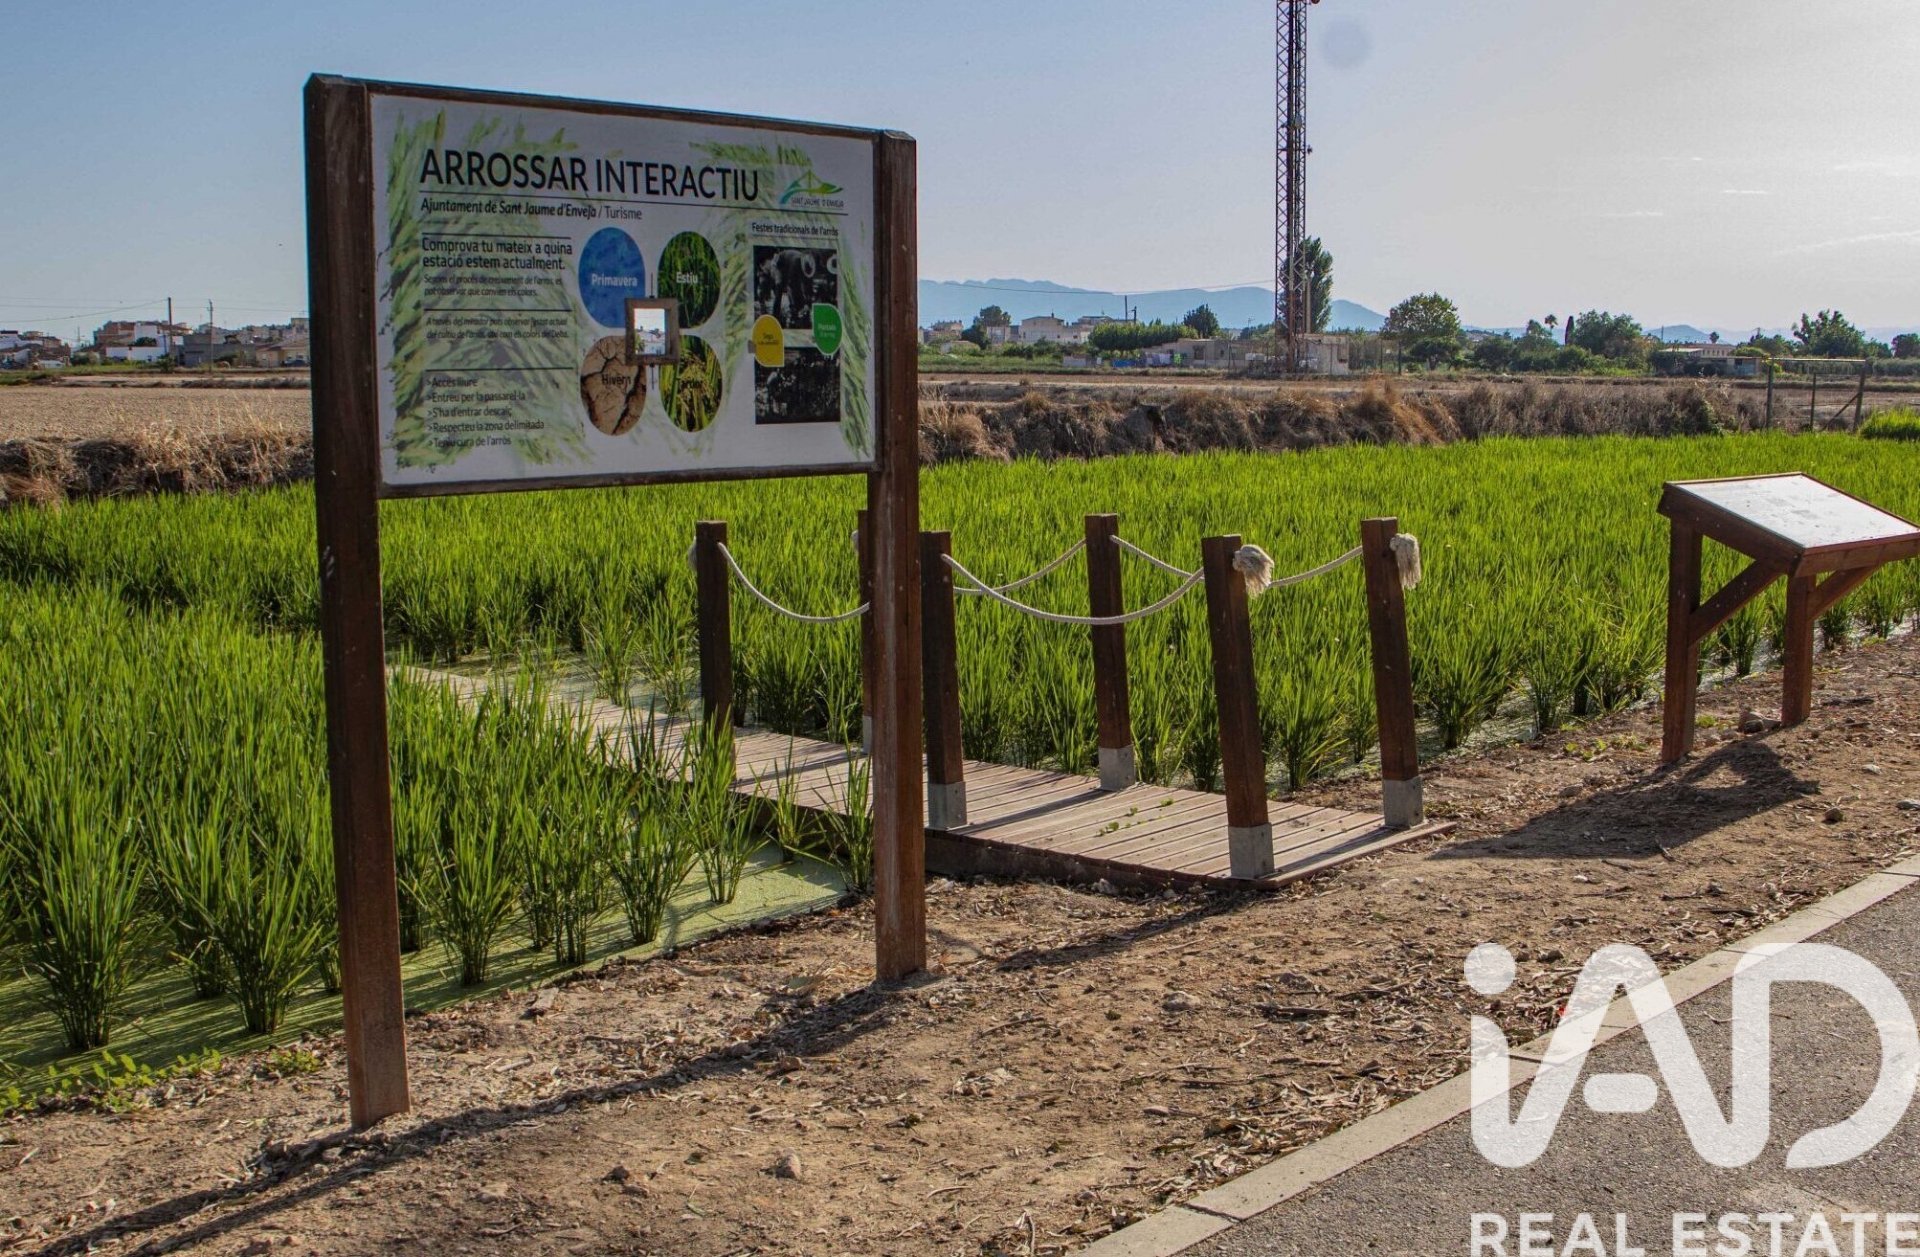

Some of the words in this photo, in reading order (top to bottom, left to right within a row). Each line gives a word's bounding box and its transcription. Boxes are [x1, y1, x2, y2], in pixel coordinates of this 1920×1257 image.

[419, 149, 589, 191] ARROSSAR
[596, 159, 758, 201] INTERACTIU
[420, 197, 483, 216] Ajuntament
[485, 198, 497, 213] de
[499, 200, 521, 214] Sant
[523, 202, 556, 216] Jaume
[604, 206, 642, 219] Turisme
[752, 222, 773, 233] Festes
[774, 223, 810, 234] tradicionals
[811, 225, 819, 233] de
[422, 237, 479, 254] Comprova
[481, 239, 493, 252] tu
[496, 240, 532, 253] mateix
[535, 243, 541, 253] a
[544, 241, 573, 255] quina
[423, 255, 463, 268] estació
[466, 257, 501, 268] estem
[502, 256, 565, 270] actualment.
[591, 273, 638, 287] Primavera
[676, 272, 699, 285] Estiu
[602, 374, 632, 386] Hivern
